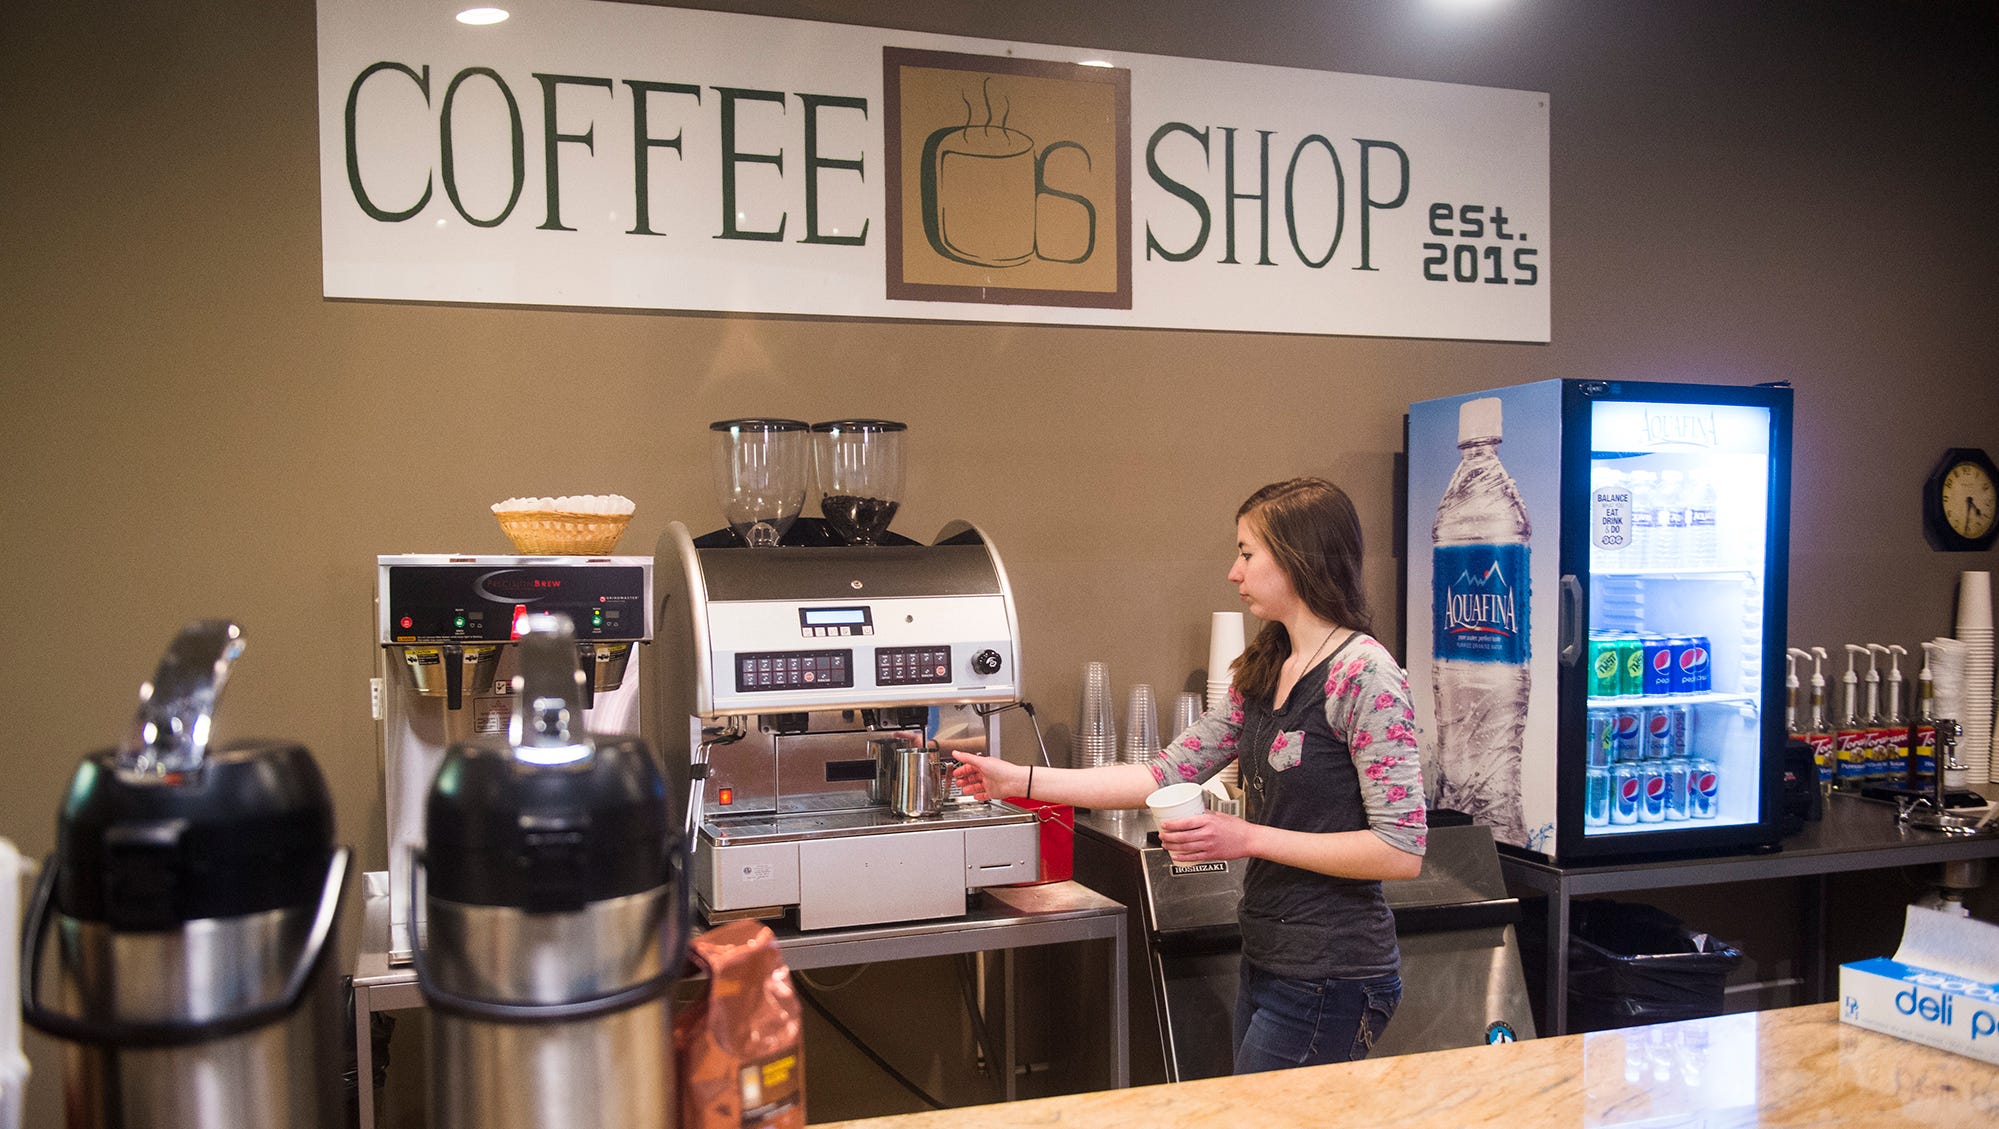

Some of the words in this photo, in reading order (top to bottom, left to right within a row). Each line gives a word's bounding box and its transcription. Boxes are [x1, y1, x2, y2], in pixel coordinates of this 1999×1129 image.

[344, 60, 870, 247] COFFEE
[1145, 121, 1410, 272] SHOP
[1428, 202, 1527, 241] est.
[1422, 242, 1538, 286] 2015
[1641, 408, 1718, 445] AQUAFINA
[1597, 494, 1628, 503] BALANCE
[1606, 508, 1619, 517] EAT
[1602, 516, 1623, 525] DRINK
[1611, 525, 1620, 534] DO
[1444, 585, 1518, 634] AQUAFINA
[1655, 677, 1670, 685] pep
[1175, 864, 1224, 874] HOSHIZAKI
[1895, 986, 1953, 1026] deli
[1971, 1009, 1999, 1040] p
